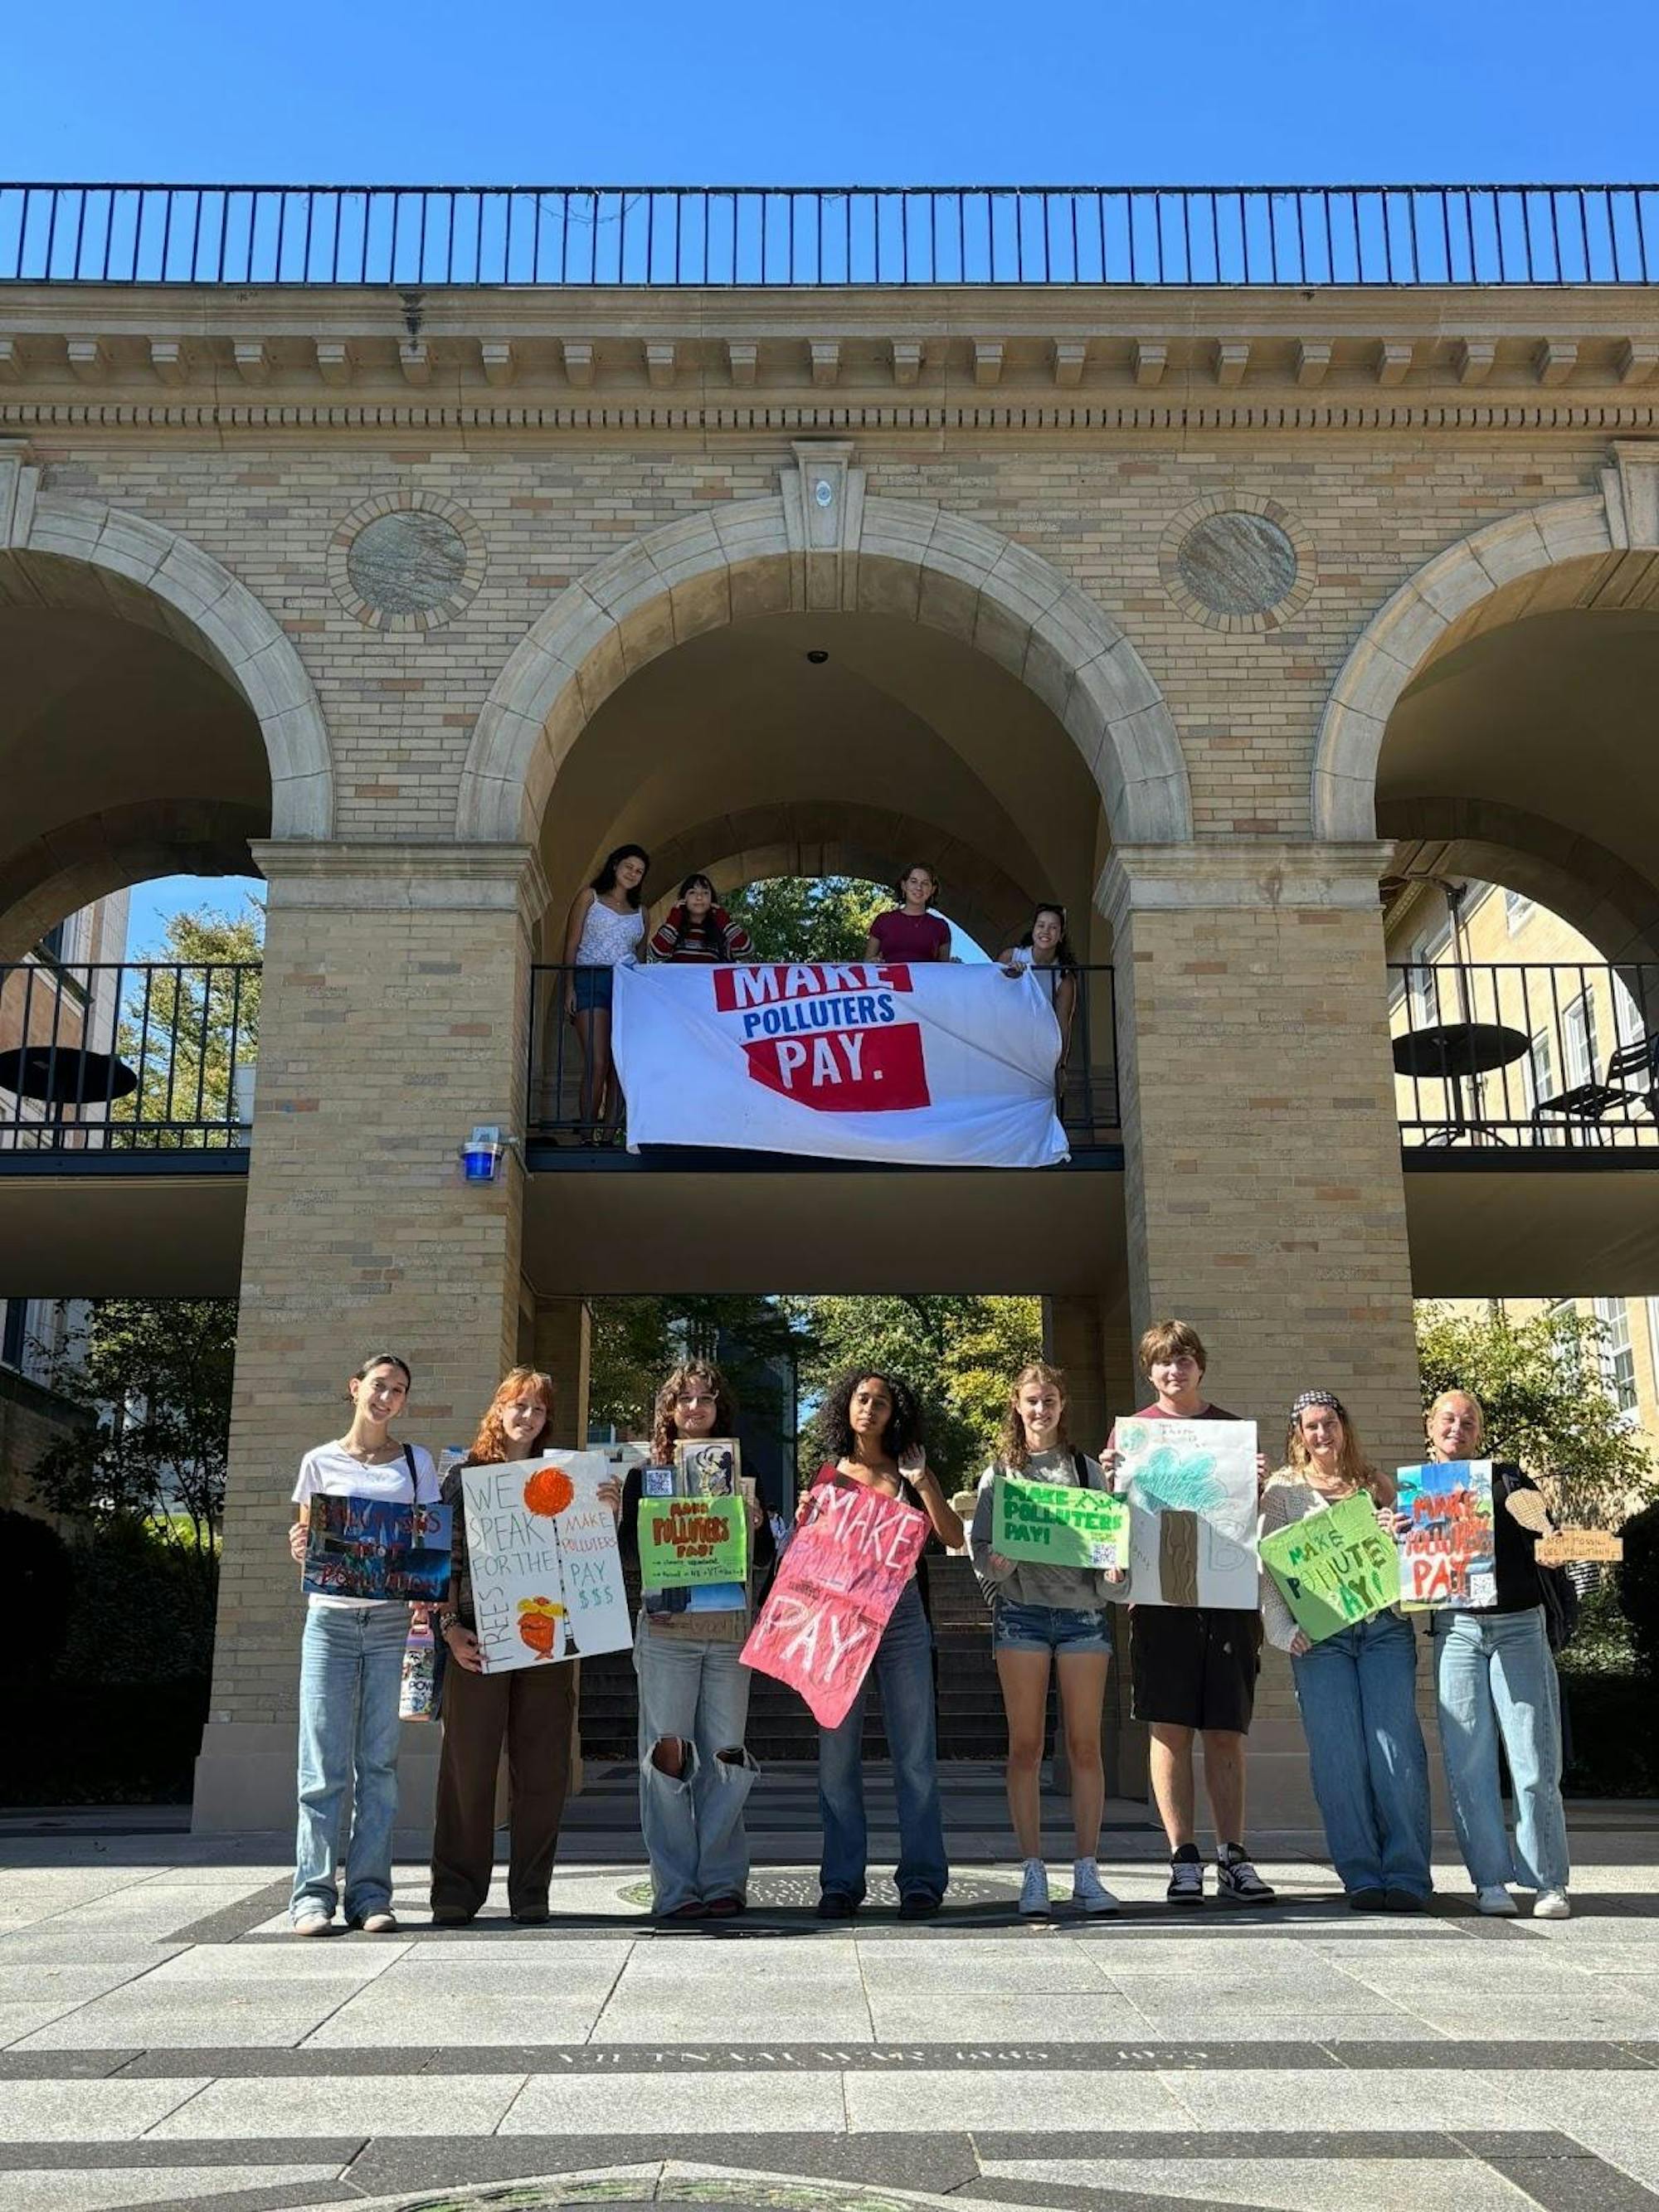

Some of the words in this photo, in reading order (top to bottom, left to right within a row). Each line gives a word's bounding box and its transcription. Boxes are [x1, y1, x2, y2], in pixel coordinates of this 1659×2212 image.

[732, 965, 894, 1008] MAKE
[743, 994, 895, 1038] POLLUTERS
[776, 1033, 883, 1089] PAY.
[465, 1473, 519, 1511] WE
[1004, 1481, 1069, 1506] MAKE
[469, 1512, 546, 1551] SPEAK
[565, 1511, 613, 1534] MAKE
[801, 1482, 923, 1569] MAKE
[1004, 1500, 1123, 1530] POLLUTERS
[1004, 1521, 1051, 1545] PAY!
[562, 1536, 617, 1554] POLLUTERS
[1288, 1529, 1344, 1566] MAKE
[472, 1554, 512, 1581] FOR
[512, 1551, 557, 1577] THE
[570, 1560, 606, 1587] PAY
[478, 1586, 514, 1673] TREES
[753, 1595, 868, 1682] PAY
